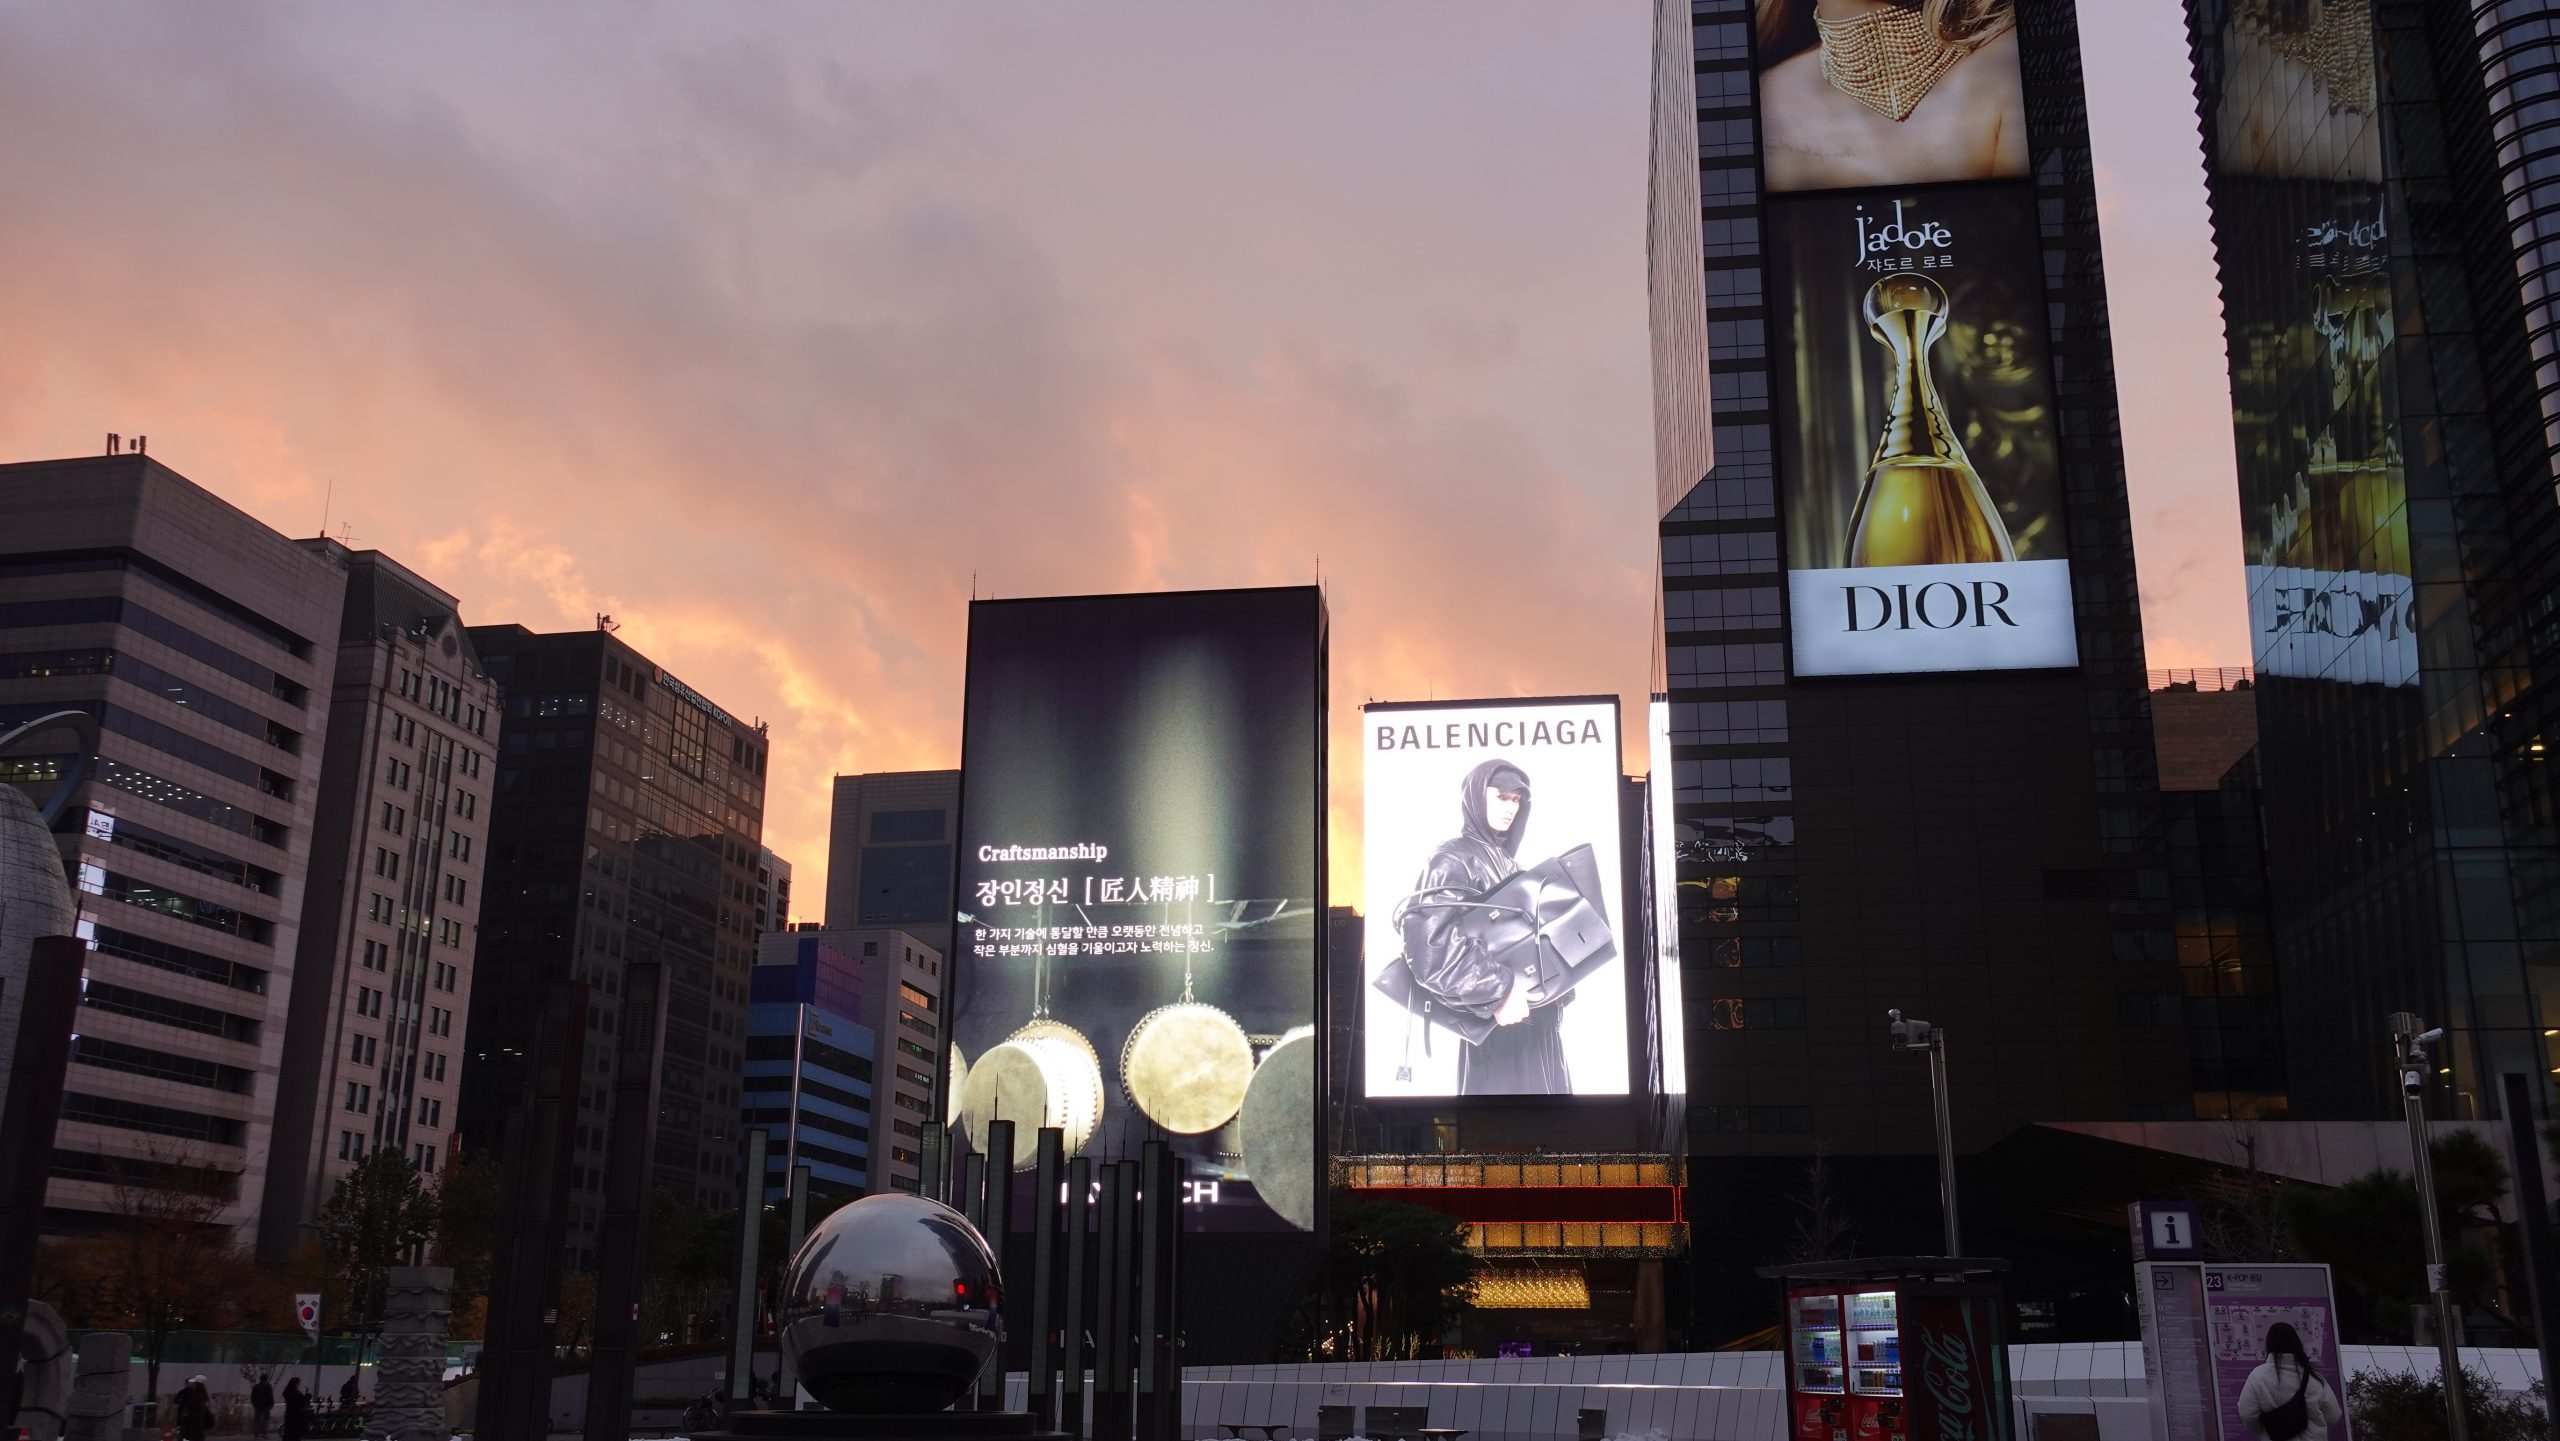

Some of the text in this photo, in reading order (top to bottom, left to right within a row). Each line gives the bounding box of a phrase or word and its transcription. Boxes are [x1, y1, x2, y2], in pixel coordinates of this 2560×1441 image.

[1855, 199, 1952, 267] j'adore
[1867, 254, 1954, 272] 쟈도르 로르
[1840, 581, 2020, 632] DIOR
[1377, 719, 1602, 750] BALENCIAGA
[978, 843, 1108, 863] Craftsmanship
[975, 878, 1068, 906] 장인정신
[975, 923, 1204, 941] 한 가지 기술에 통달할 만큼 오랫동안 전념하고
[974, 939, 1215, 957] 작은 부분까지 심혈을 기울이고자 노력하는 정신.
[2206, 1275, 2222, 1288] 23
